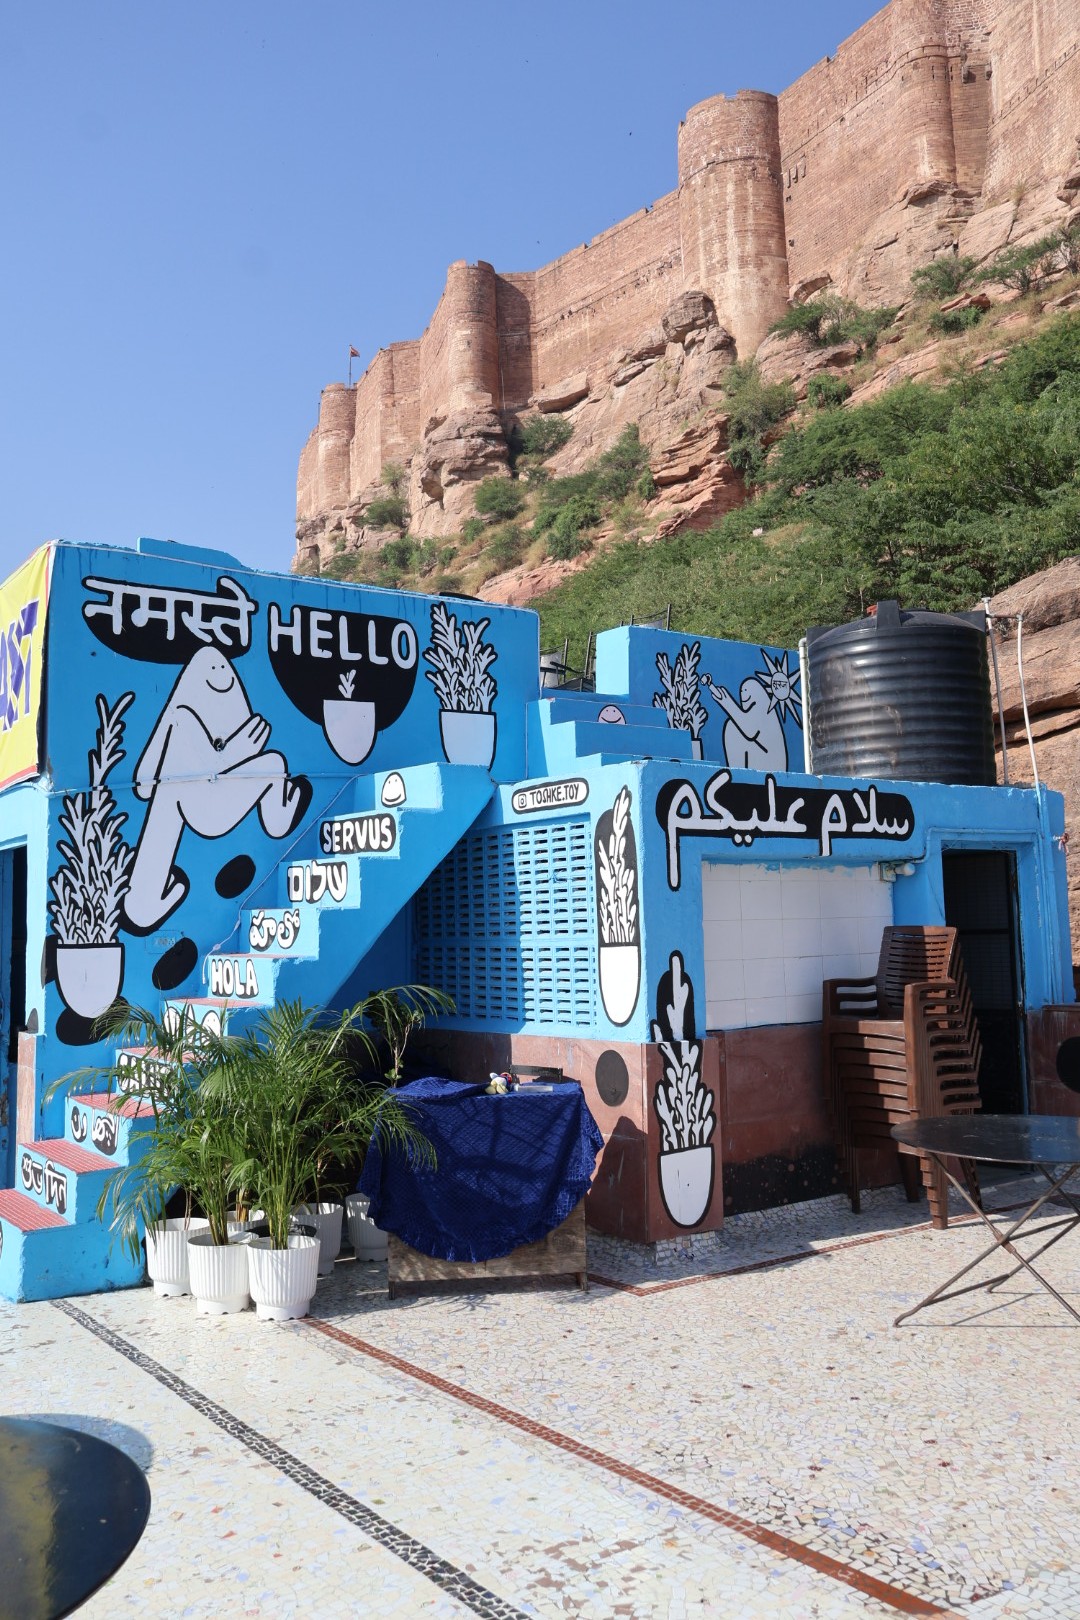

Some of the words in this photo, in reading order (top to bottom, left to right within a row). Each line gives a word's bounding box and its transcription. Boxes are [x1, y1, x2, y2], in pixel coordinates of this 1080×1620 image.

[84, 577, 256, 648] नमस्ते
[269, 604, 416, 669] HELLO
[322, 816, 394, 853] SERVUS
[821, 787, 910, 857] سلام
[287, 860, 348, 902] שלום
[211, 959, 258, 997] HOLA
[22, 1154, 43, 1194] শুভ
[44, 1159, 67, 1210] দিন
